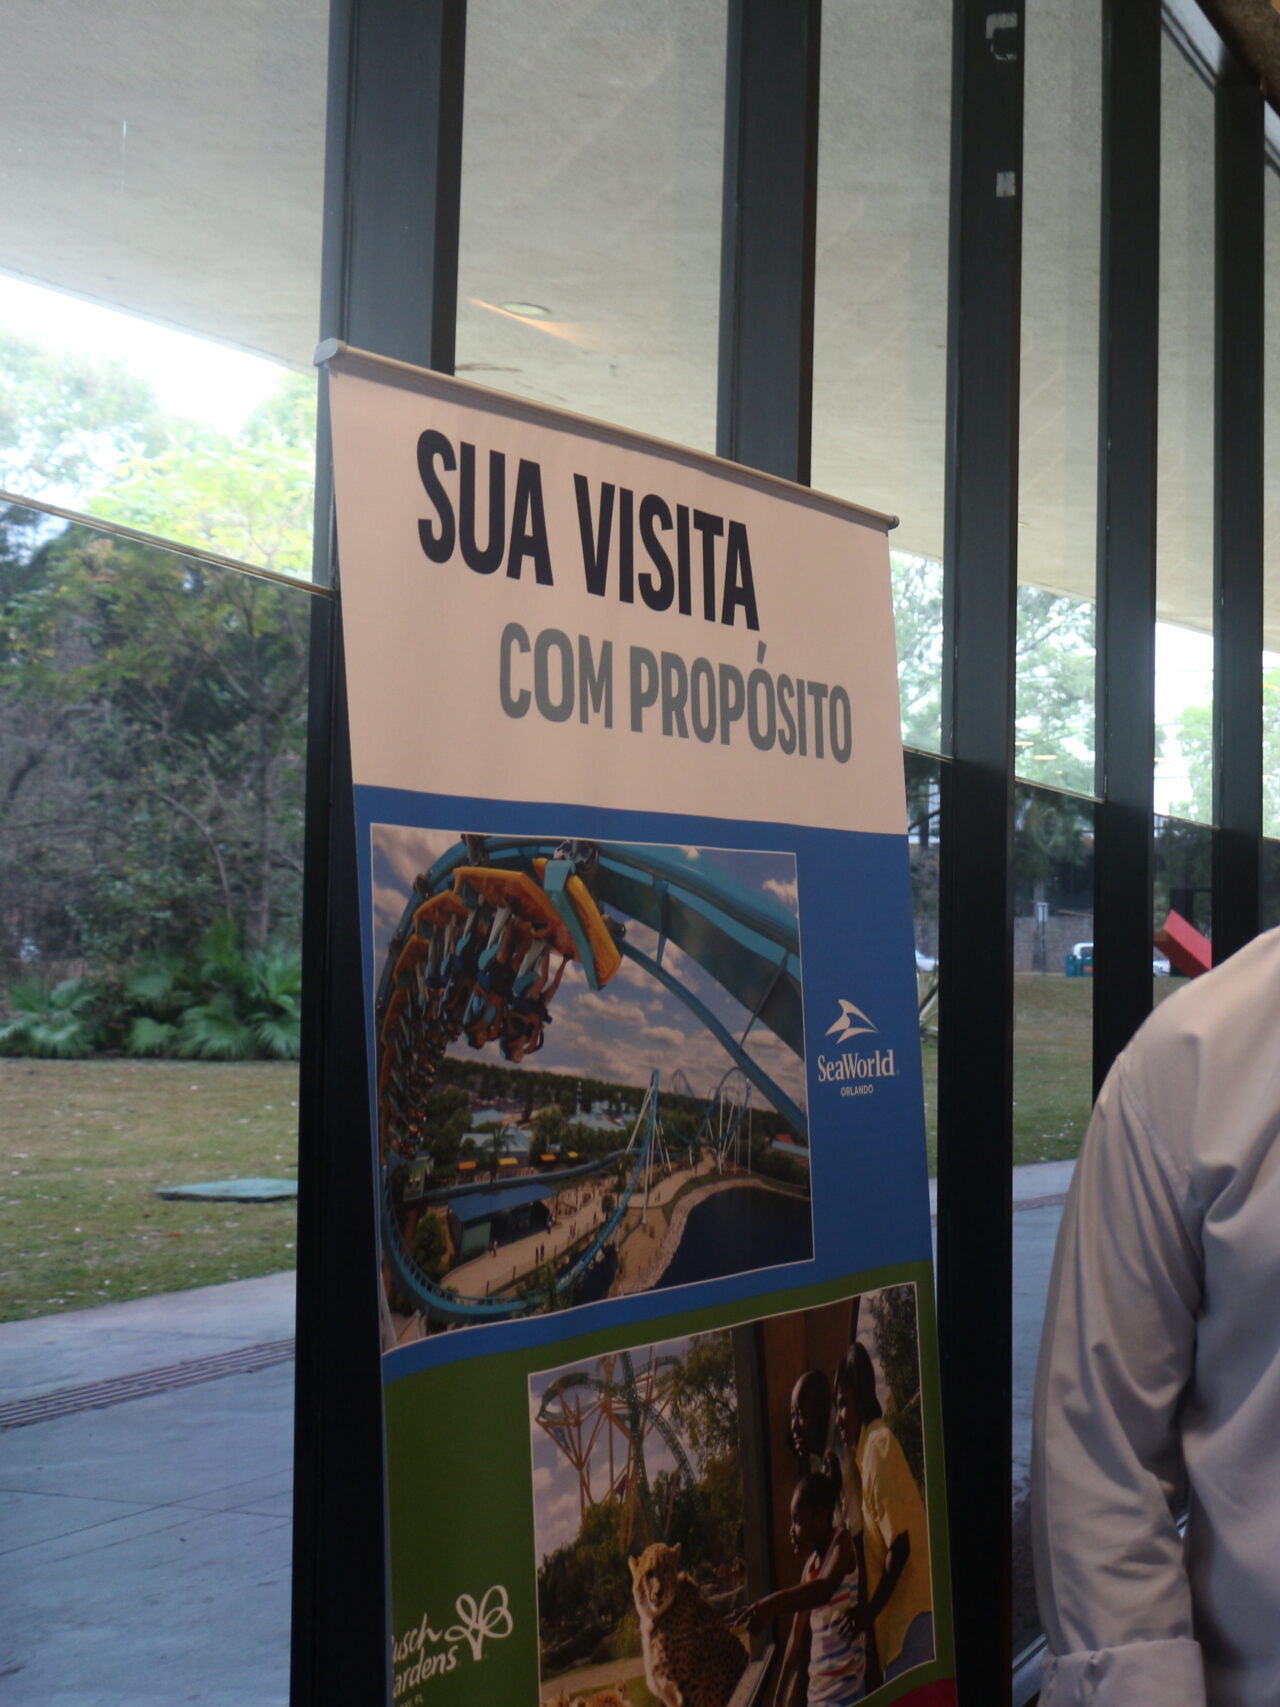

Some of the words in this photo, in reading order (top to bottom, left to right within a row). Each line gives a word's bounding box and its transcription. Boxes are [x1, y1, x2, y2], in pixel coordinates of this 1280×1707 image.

[417, 429, 554, 586] SUA
[573, 472, 760, 632] VISITA
[500, 621, 613, 729] COM
[629, 639, 853, 764] PROPÓSITO
[817, 1049, 895, 1081] SeaWorld
[840, 1084, 874, 1097] ORLANDO
[392, 1612, 443, 1663] usch
[392, 1645, 459, 1698] ardens
